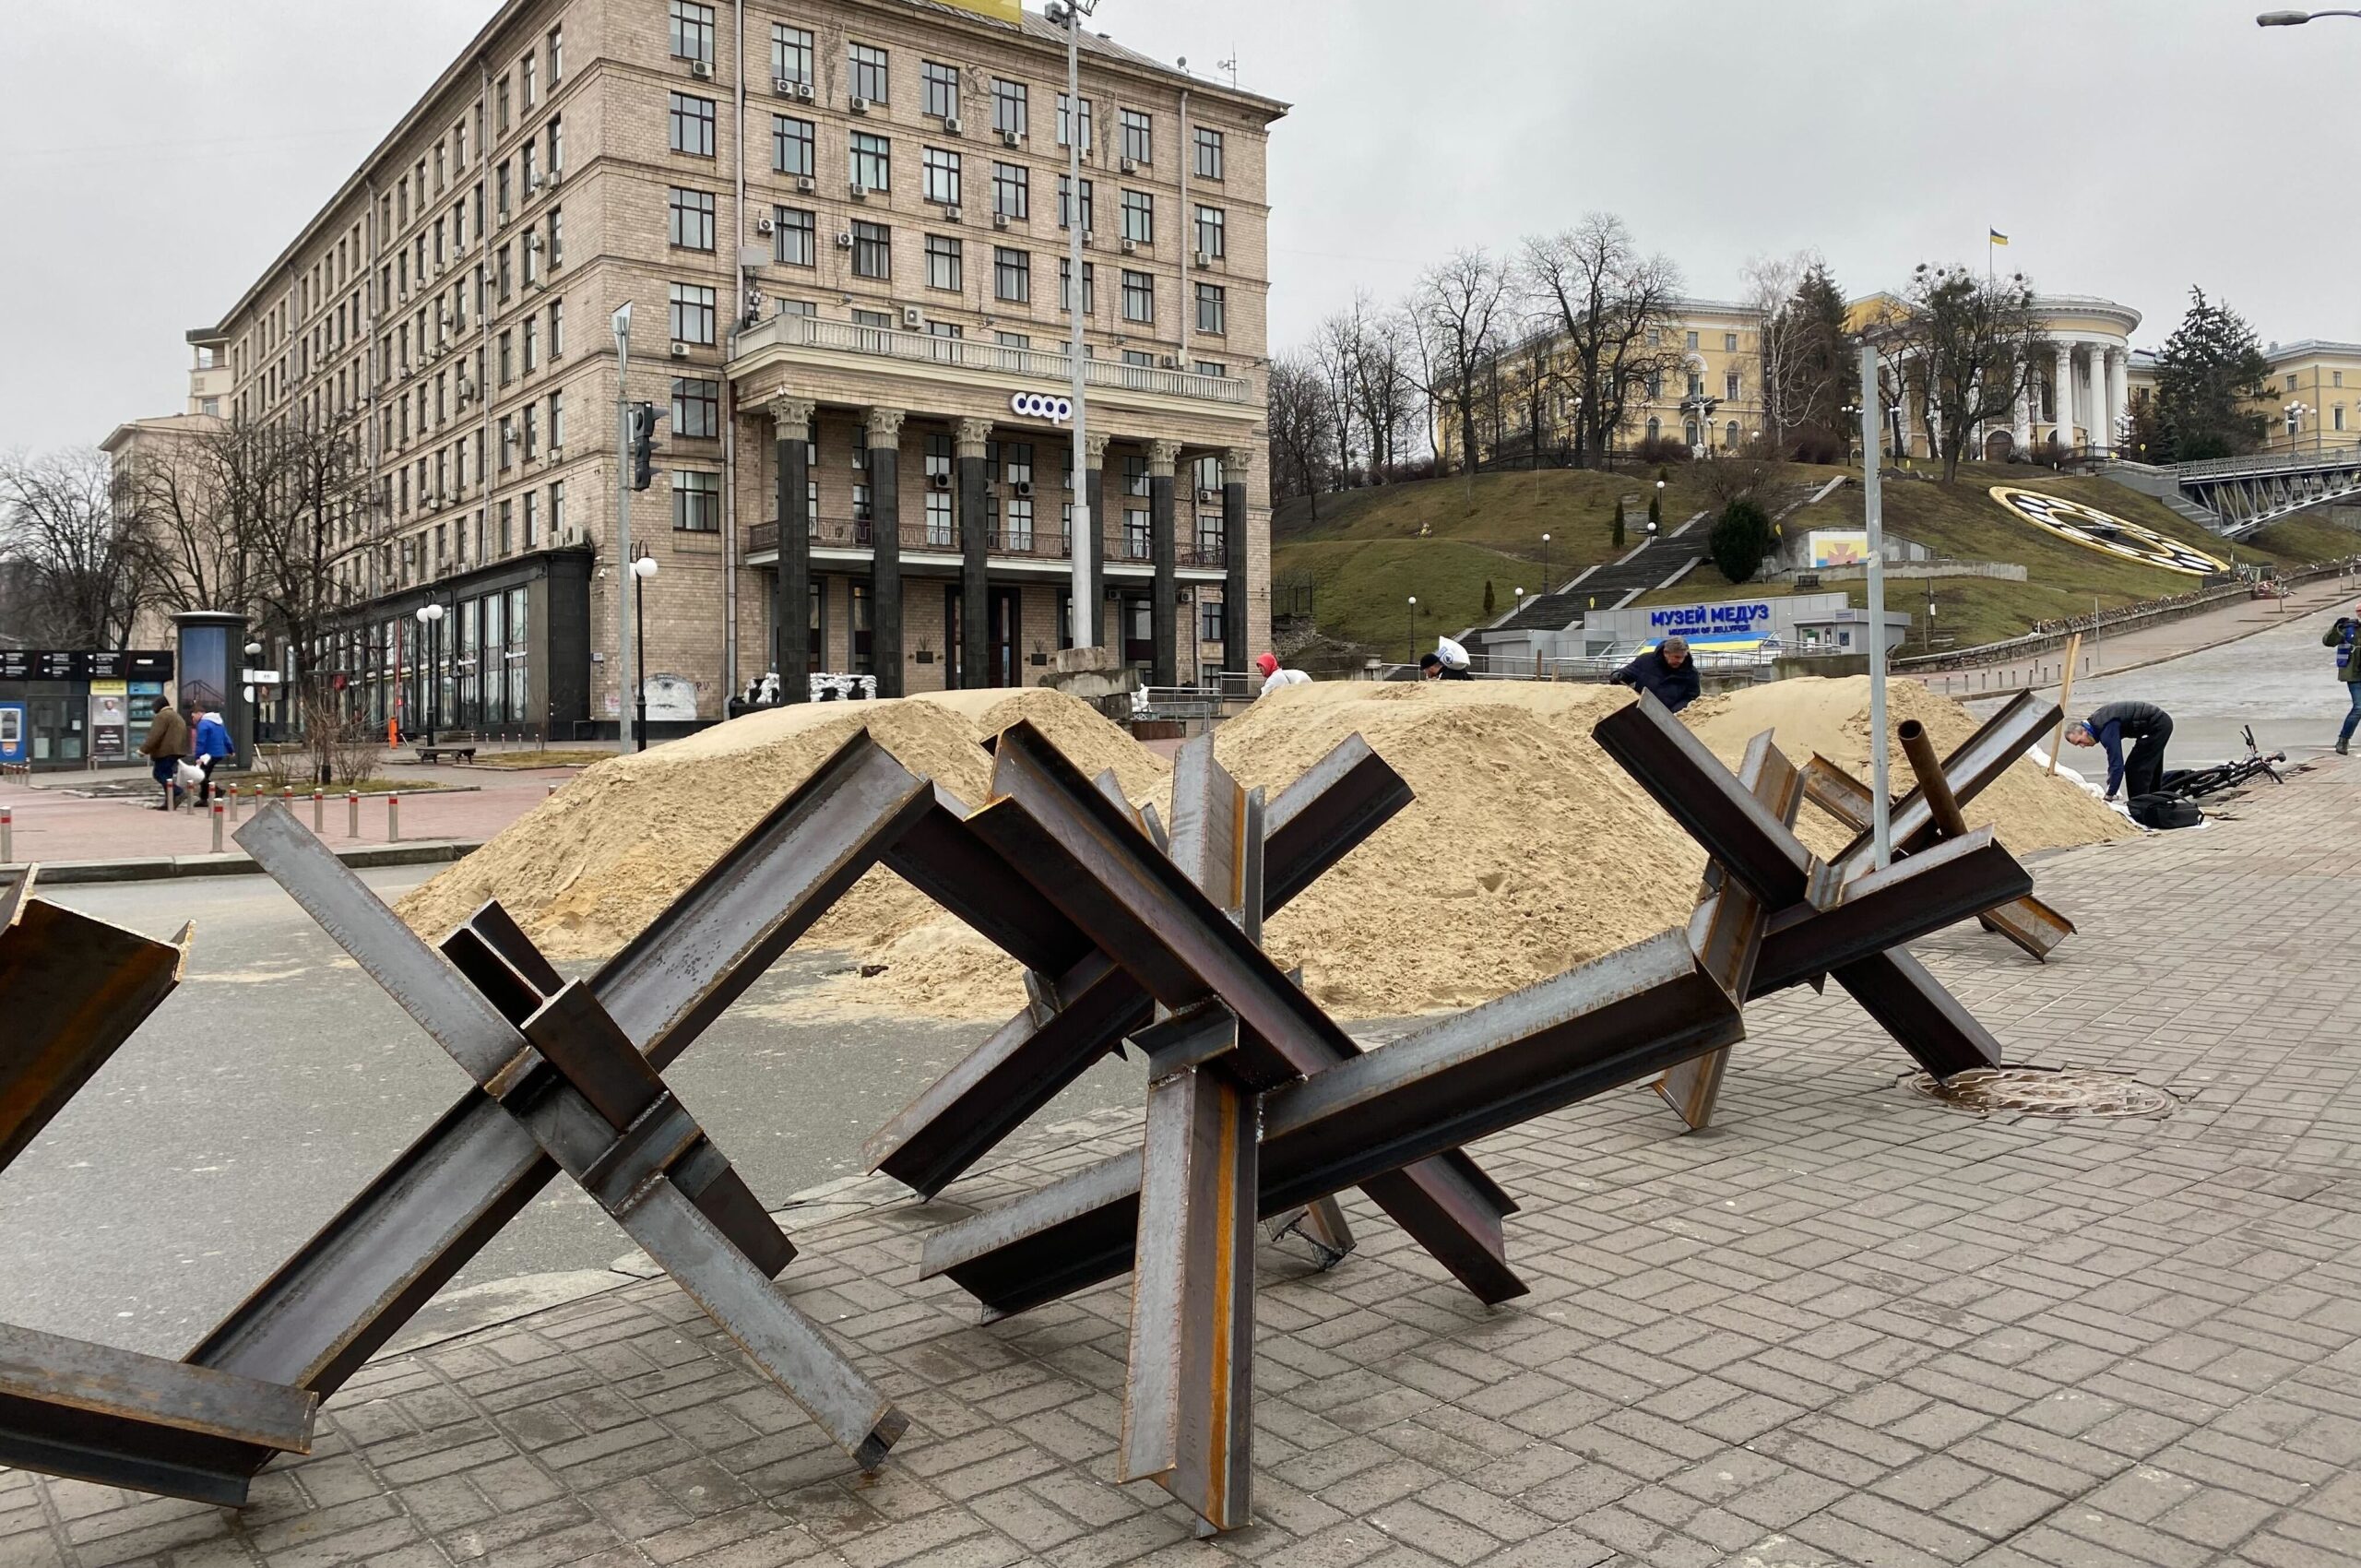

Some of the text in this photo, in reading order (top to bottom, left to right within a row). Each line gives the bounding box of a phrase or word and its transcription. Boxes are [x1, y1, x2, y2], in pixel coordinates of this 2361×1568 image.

[1012, 392, 1073, 424] coop
[1651, 604, 1769, 626] МУЗЕЙ МЕДУЗ
